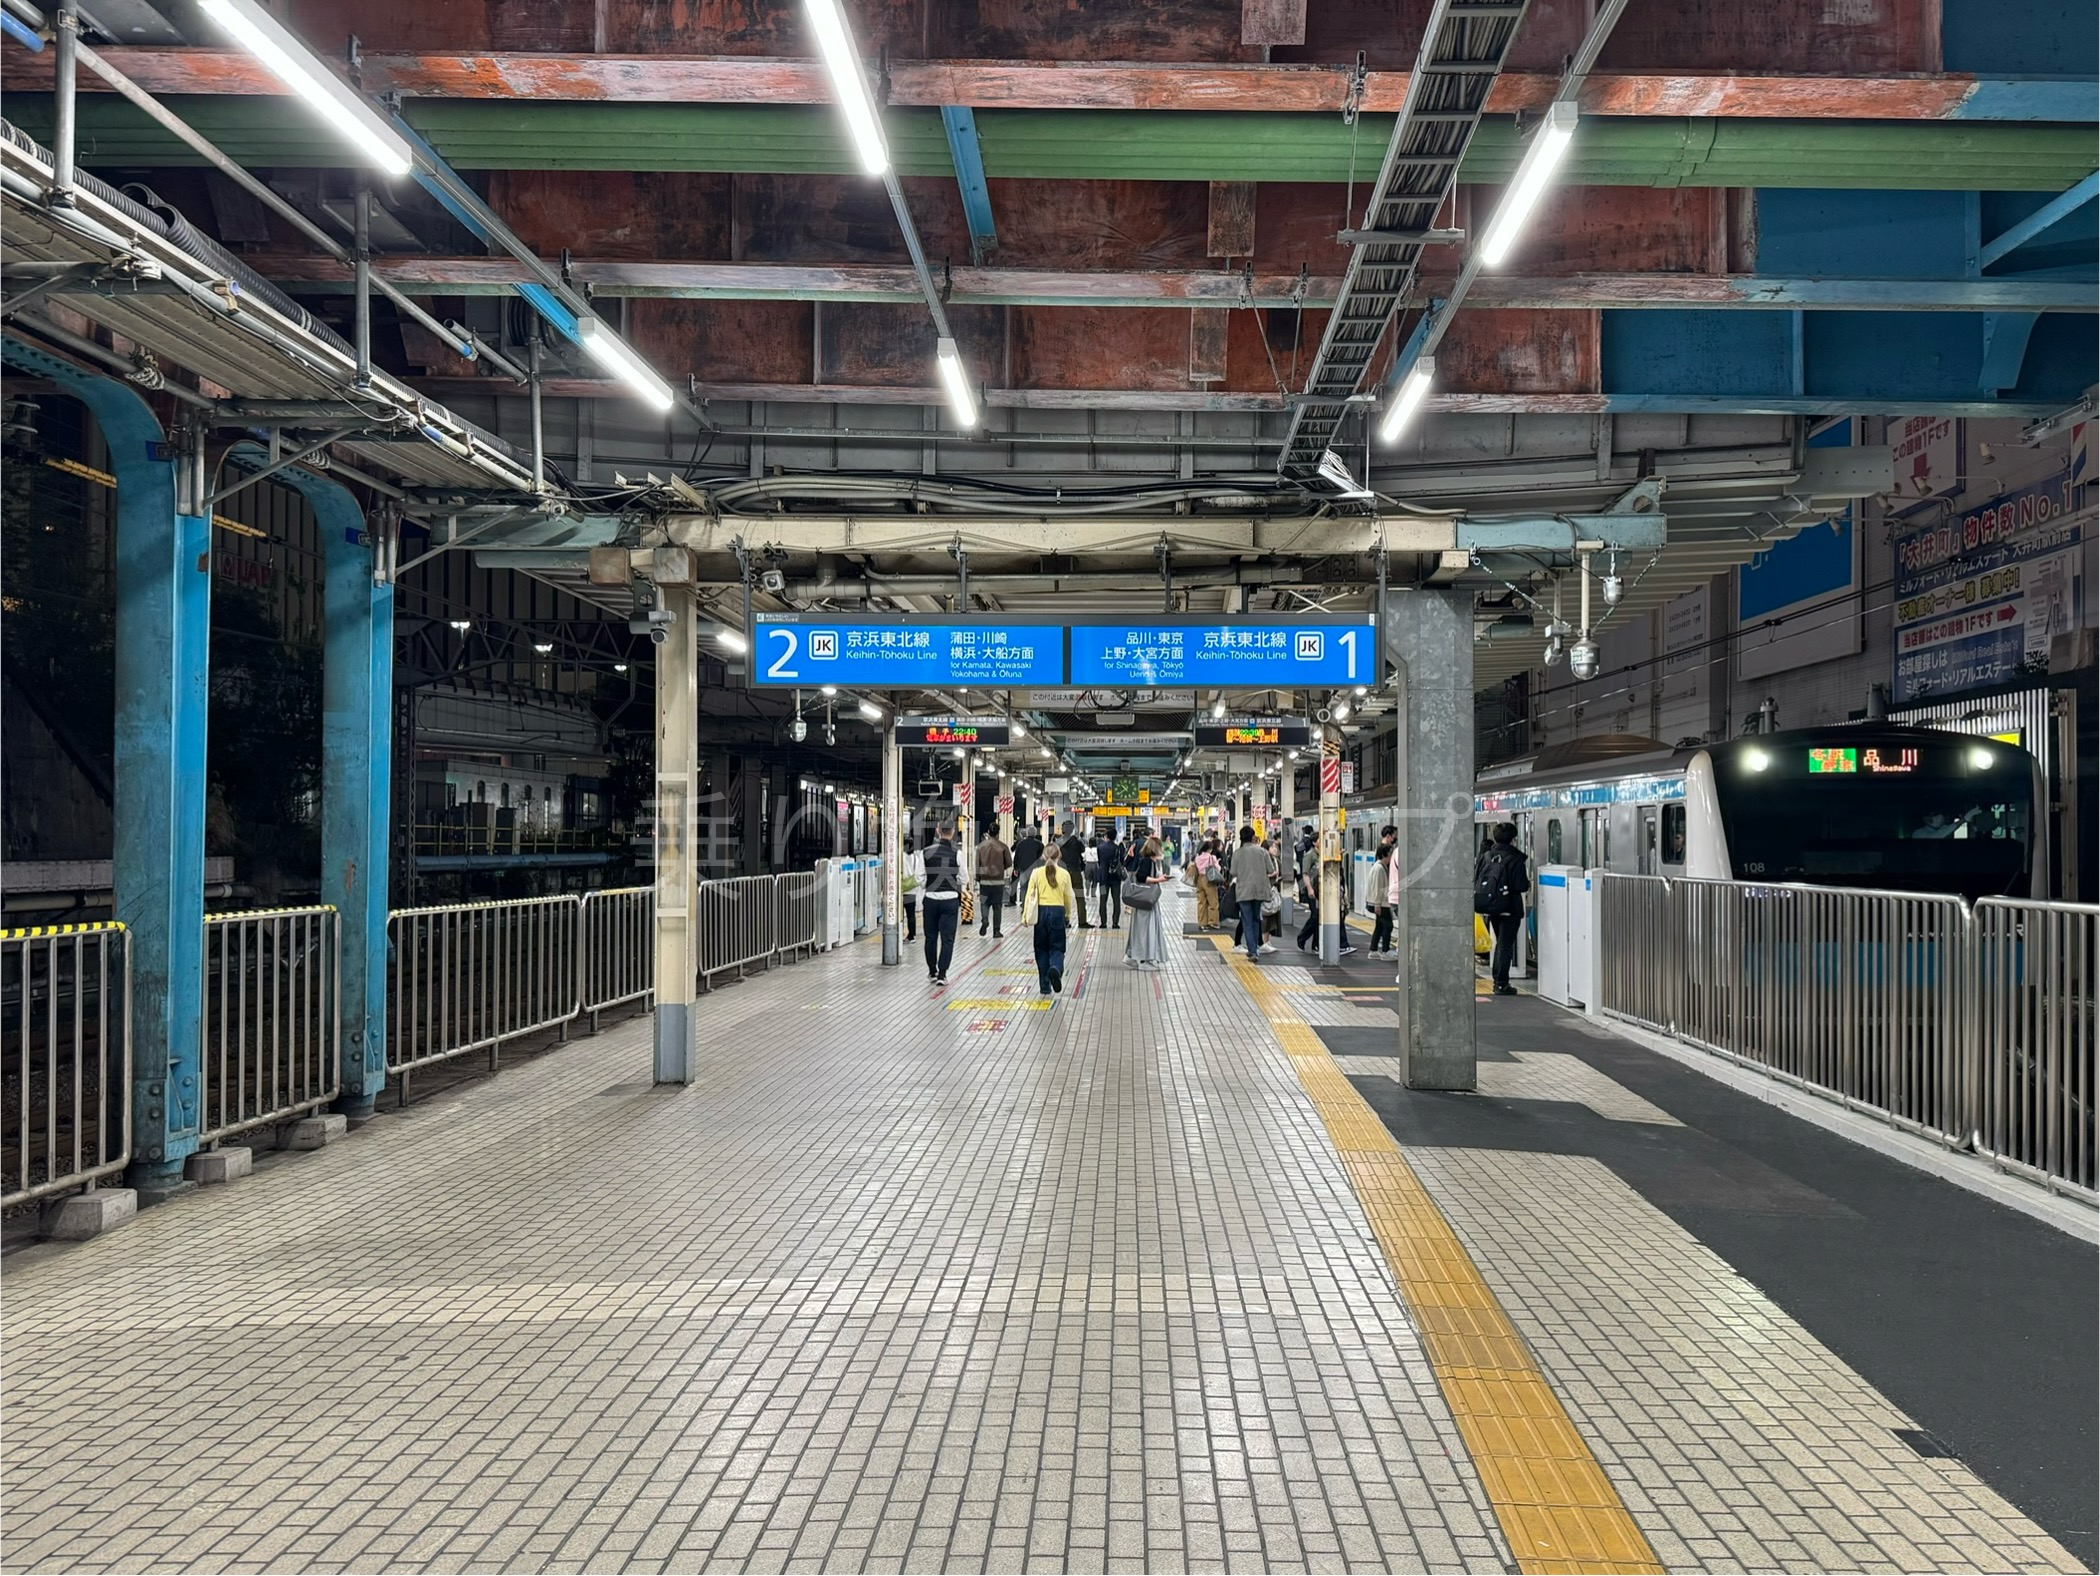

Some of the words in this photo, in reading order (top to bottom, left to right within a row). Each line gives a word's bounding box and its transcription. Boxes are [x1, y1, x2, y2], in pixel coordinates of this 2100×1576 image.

[2019, 481, 2072, 530] No.1
[846, 631, 930, 648] 京浜東北線
[950, 631, 1008, 645] 蒲田・川崎
[1126, 632, 1184, 645] 品川・東京
[1203, 631, 1287, 648] 京浜東北線
[815, 639, 832, 652] JK
[1300, 640, 1317, 652] JK
[767, 629, 799, 678] 2
[917, 650, 938, 660] Line
[950, 646, 1034, 661] 横浜・大船方面
[1100, 646, 1184, 661] 上野・大宮方面
[1266, 650, 1287, 660] Line
[1338, 631, 1356, 679] 1
[950, 661, 960, 669] for
[995, 661, 1032, 669] Kawasaki
[1104, 661, 1114, 669] for
[950, 670, 990, 678] Yokohama
[991, 670, 997, 678] &
[897, 717, 904, 726] 2
[1302, 718, 1306, 727] 1
[1863, 749, 1918, 766] 品川
[1743, 862, 1766, 873] 108
